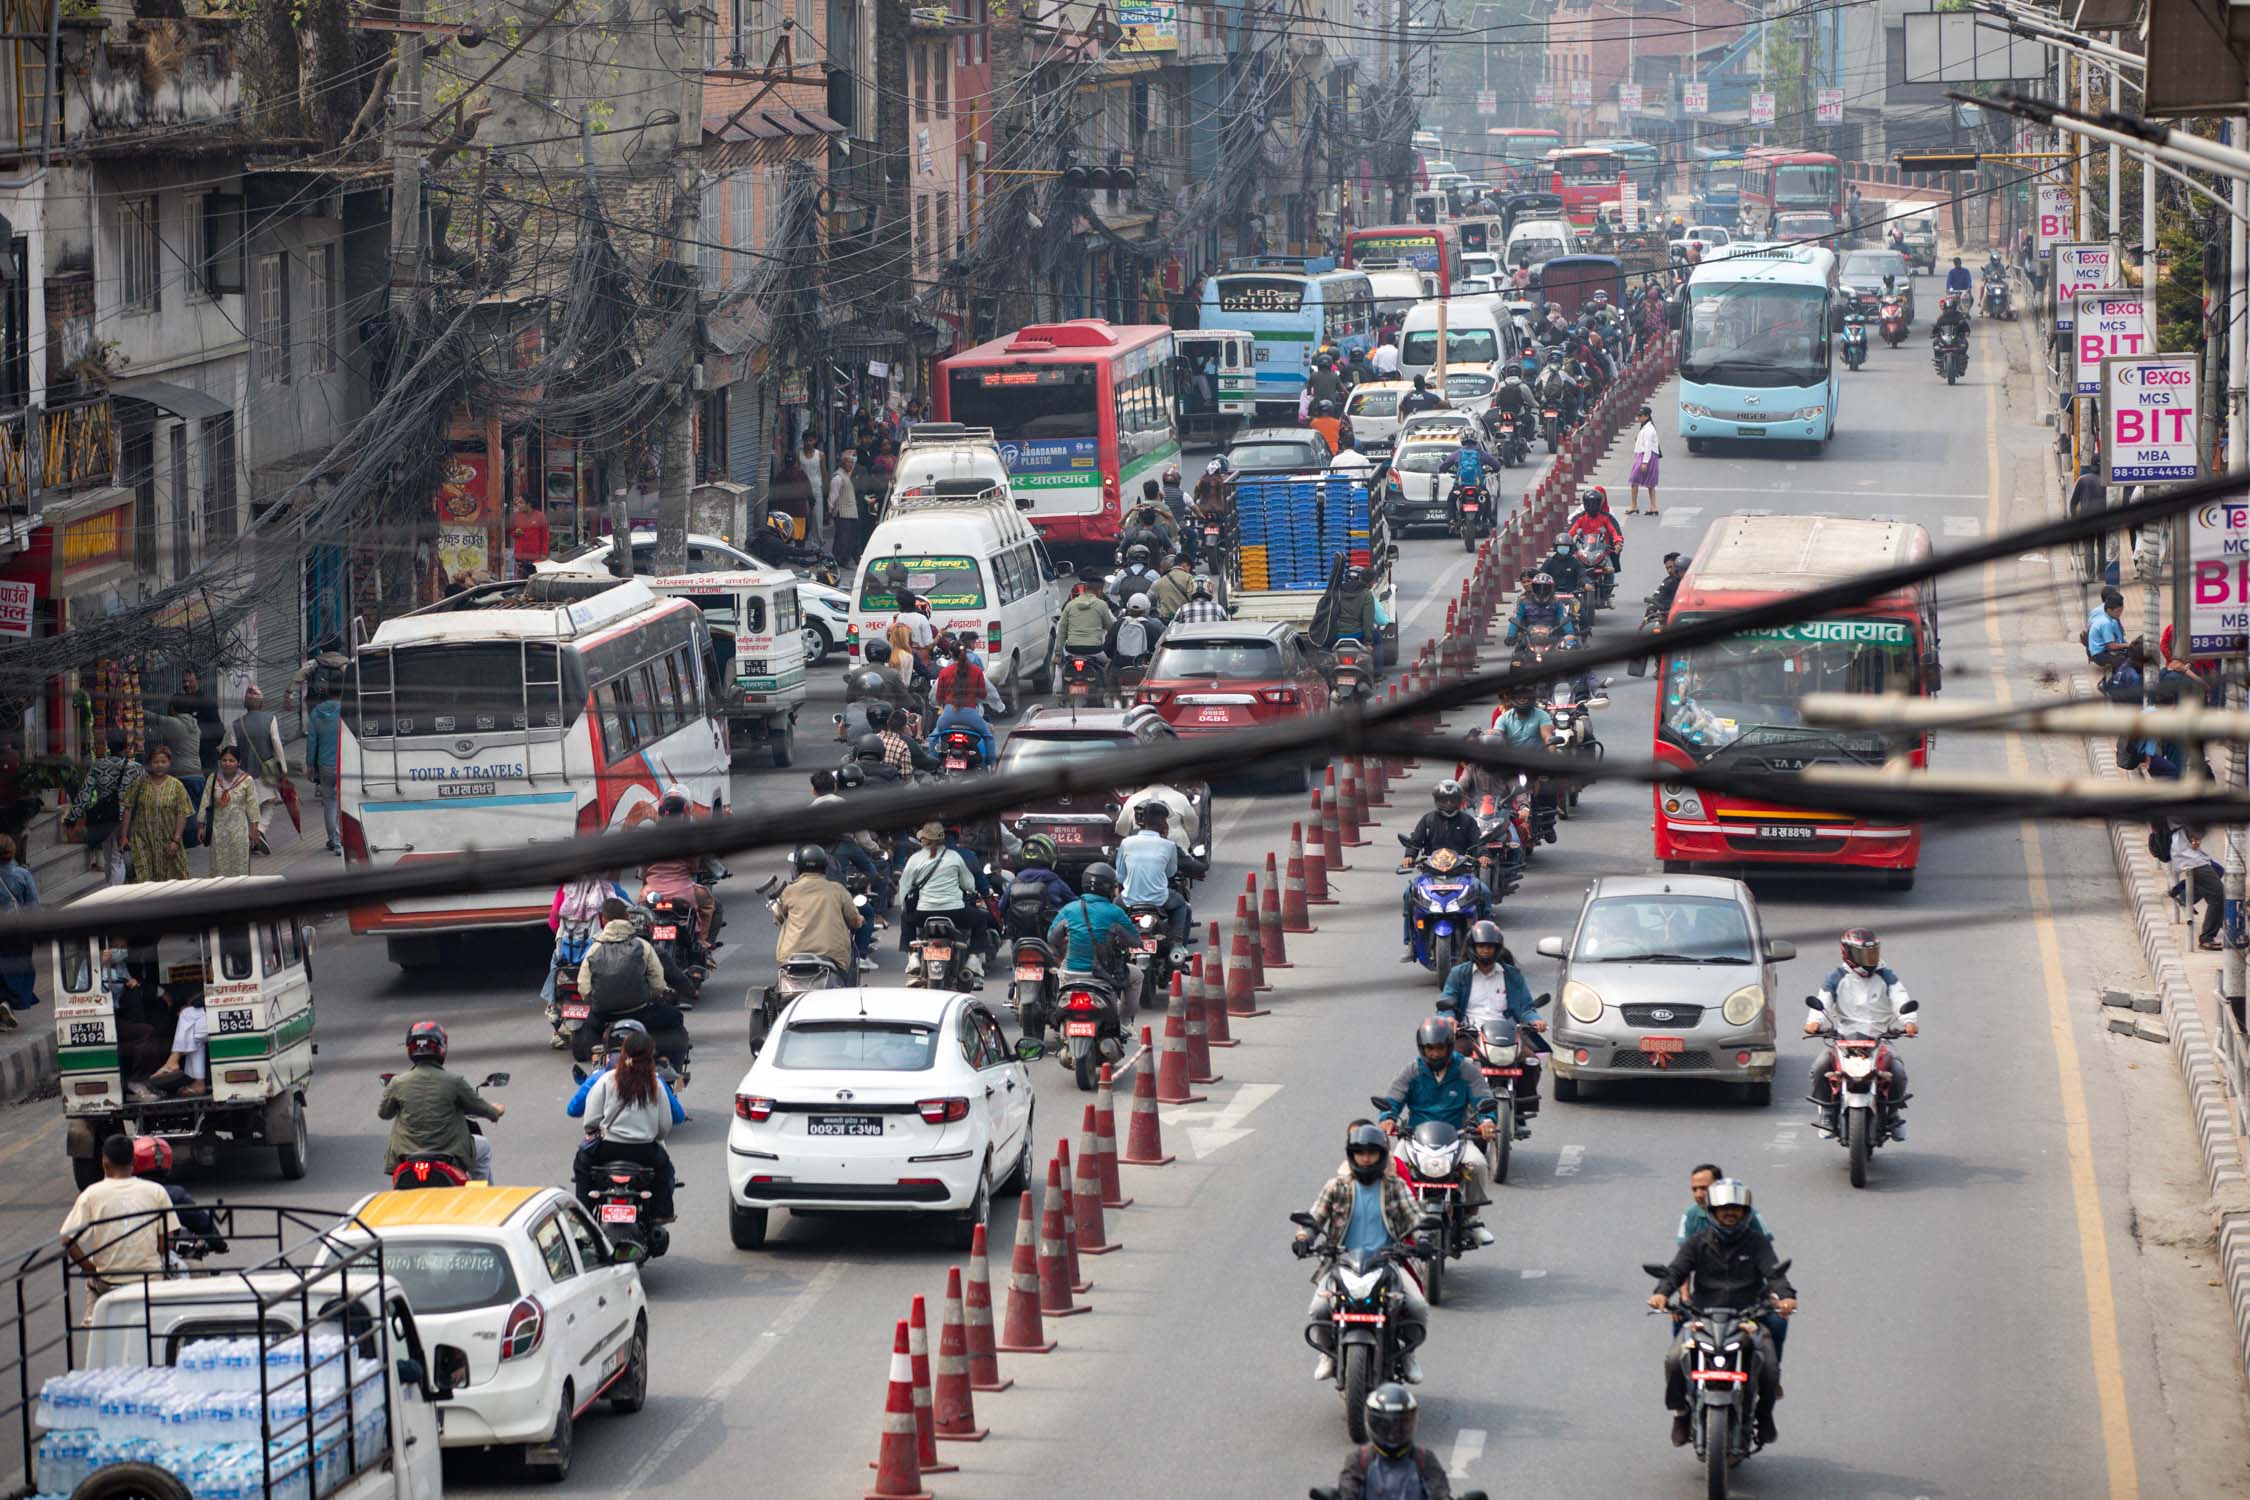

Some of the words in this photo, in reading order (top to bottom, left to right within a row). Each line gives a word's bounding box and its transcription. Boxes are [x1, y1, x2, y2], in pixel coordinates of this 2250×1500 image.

[2076, 250, 2109, 264] Texa
[2076, 269, 2100, 278] MCS
[1224, 297, 1299, 310] DELUXE
[2100, 321, 2127, 331] MCS
[2137, 366, 2191, 385] Texas
[2139, 393, 2170, 404] MCS
[2116, 409, 2192, 443] BIT
[1021, 446, 1067, 456] JAGADAMBA
[2137, 450, 2170, 462] MBA
[1021, 456, 1052, 465] PLASTIC
[2114, 467, 2195, 477] 98-016-44458
[1030, 474, 1089, 485] यातायात
[2195, 560, 2249, 604] BI
[1801, 621, 1906, 642] यातायात
[409, 767, 445, 781] TOUR
[450, 766, 460, 779] &
